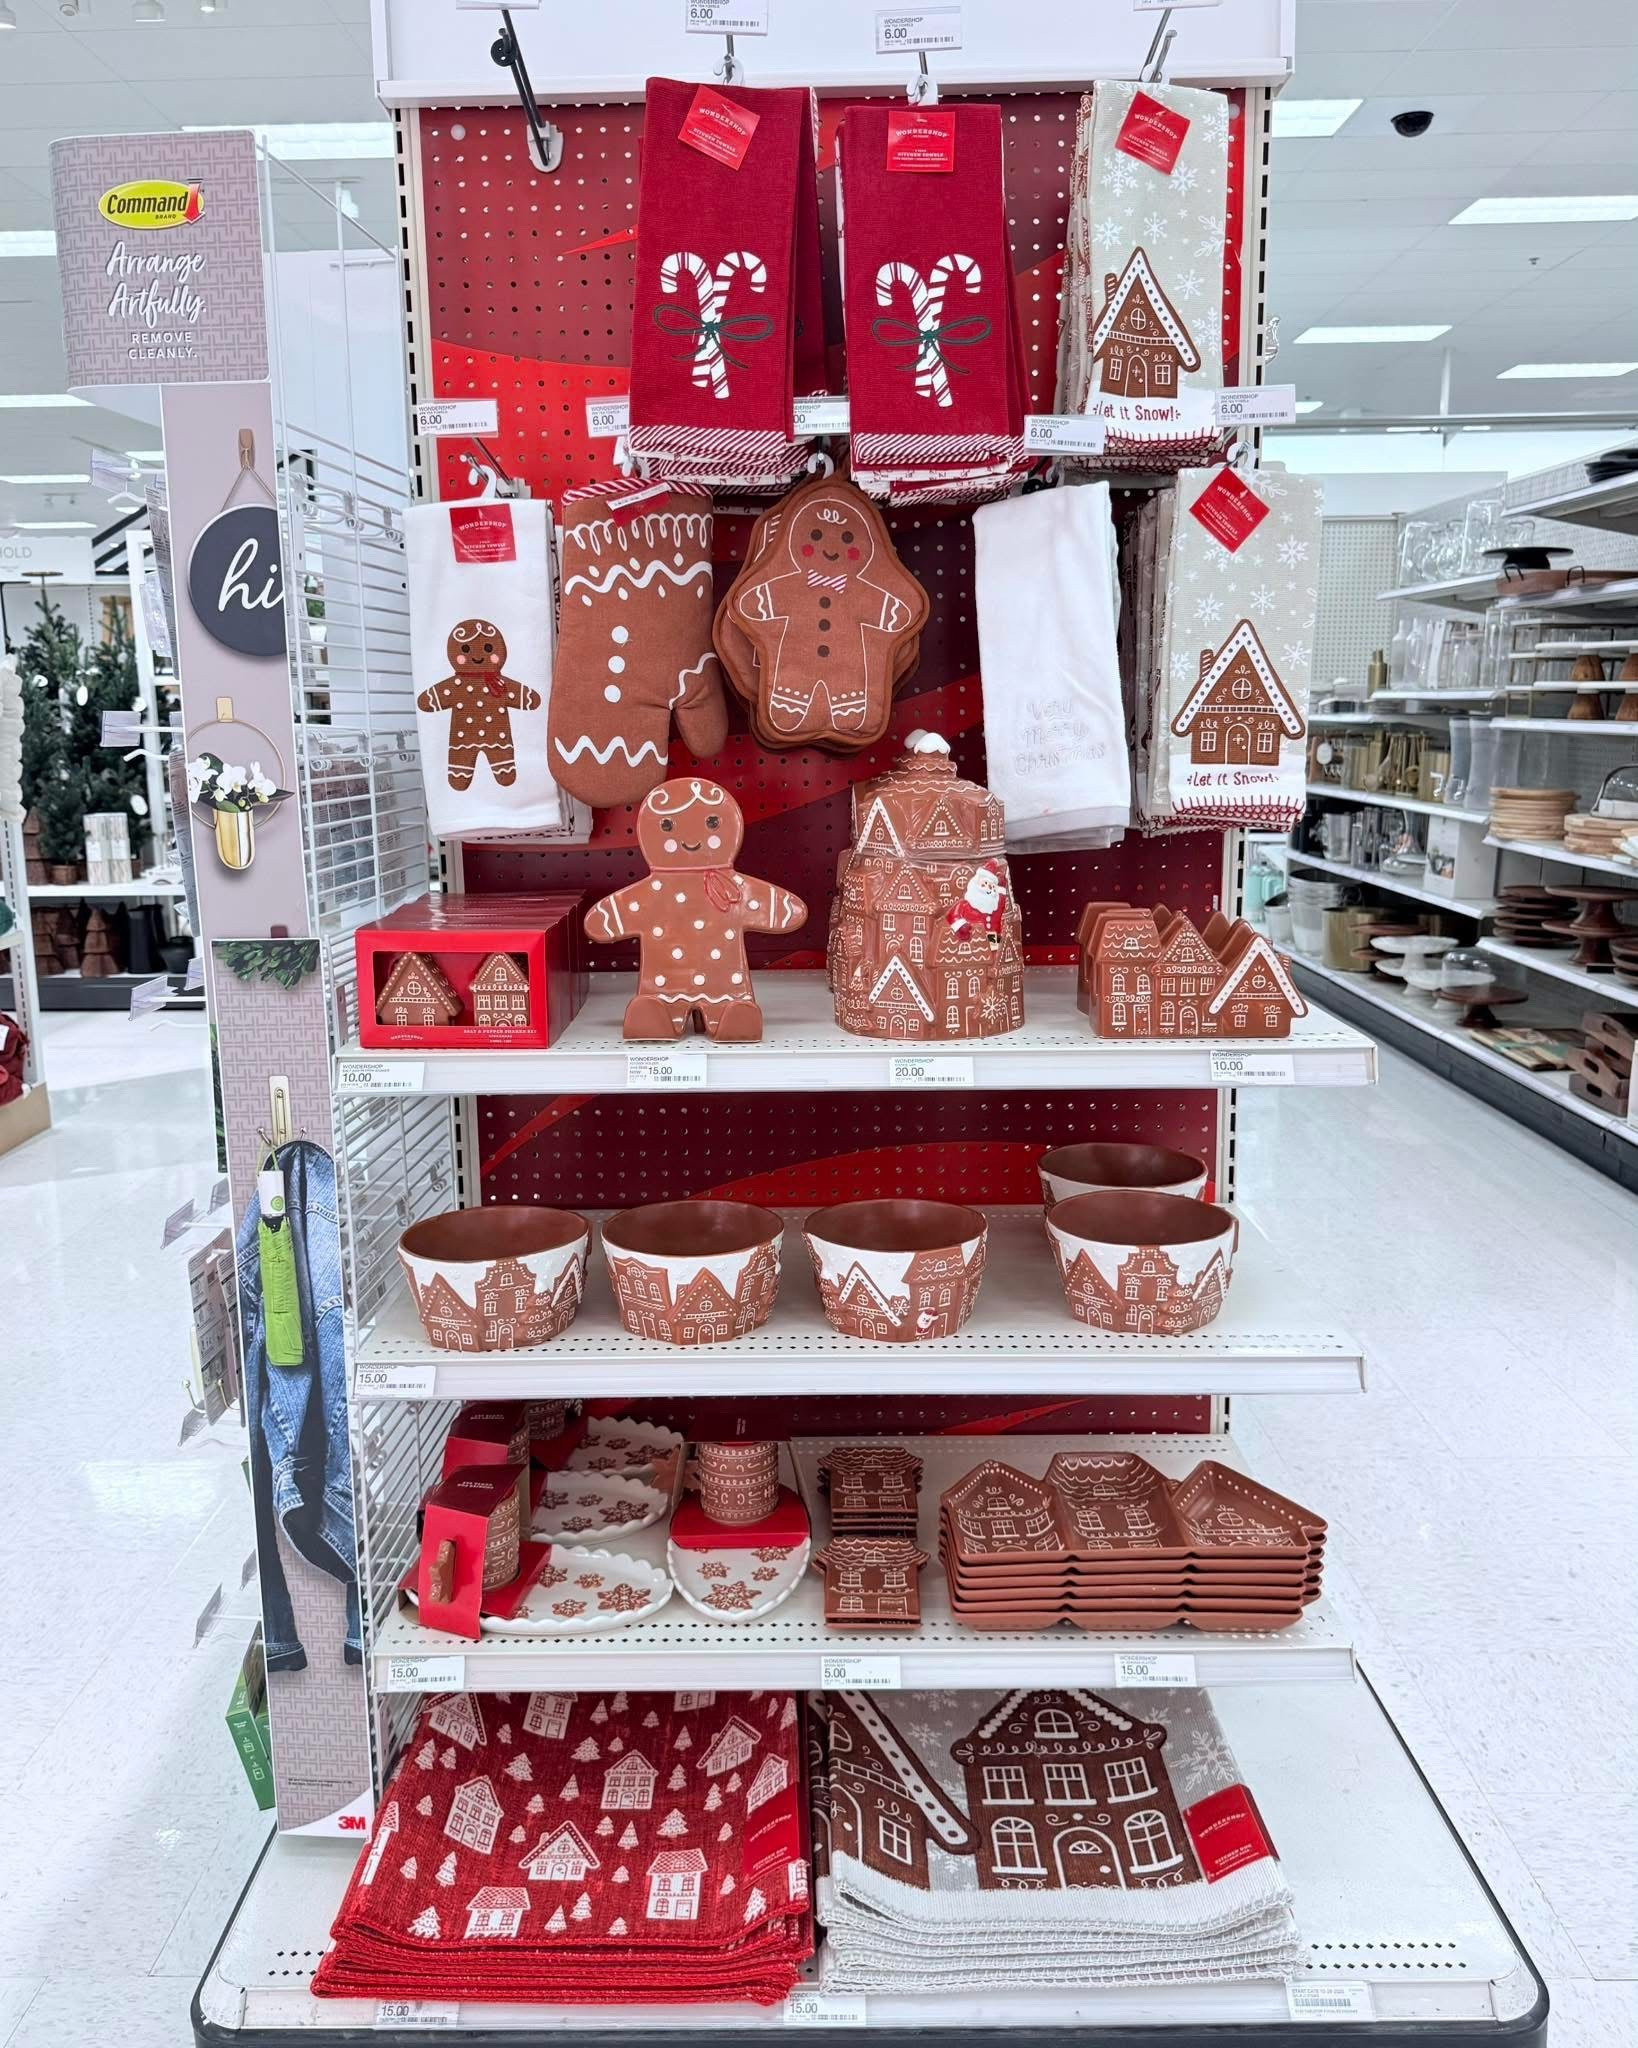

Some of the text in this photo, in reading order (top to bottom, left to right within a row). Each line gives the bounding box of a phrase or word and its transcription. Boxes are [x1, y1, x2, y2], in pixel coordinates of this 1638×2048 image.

[691, 9, 713, 19] 6.00
[884, 17, 923, 25] WONDERSHOP
[885, 29, 907, 39] 6.00
[698, 107, 747, 136] WONDERSHOP
[1133, 113, 1178, 140] WONDERSHOP
[895, 128, 948, 138] WONDERSHOP
[107, 191, 188, 214] Command
[107, 240, 206, 283] Arrange
[108, 278, 206, 328] Artfully.
[132, 332, 192, 344] REMOVE
[129, 347, 198, 360] CLEANLY.
[419, 404, 457, 412] WONDERSHOP
[1119, 403, 1131, 421] it
[1135, 404, 1174, 421] Snow!
[1221, 404, 1243, 414] 6.00
[420, 415, 442, 426] 6.00
[593, 415, 614, 426] 6.00
[1031, 418, 1070, 426] WONDERSHOP
[1031, 428, 1052, 439] 6.00
[1216, 485, 1254, 522] WONDERSHOP
[459, 519, 507, 531] WONDERSHOP
[0, 546, 32, 559] OLD
[218, 538, 285, 612] hi
[1193, 772, 1274, 787] Let it Snow!
[648, 1066, 673, 1075] 15.00
[1214, 1061, 1243, 1071] 10.00
[343, 1072, 372, 1083] 10.00
[895, 1067, 924, 1077] 20.00
[360, 1373, 388, 1383] 15.00
[391, 1667, 418, 1678] 15.00
[824, 1668, 846, 1678] 5.00
[1122, 1665, 1148, 1675] 15.00
[337, 1815, 366, 1830] 3M
[1199, 1812, 1247, 1839] WONDERSHOP
[749, 1814, 792, 1843] WONDERSHOP
[382, 2005, 409, 2016] 15.00
[790, 2002, 818, 2013] 15.00
